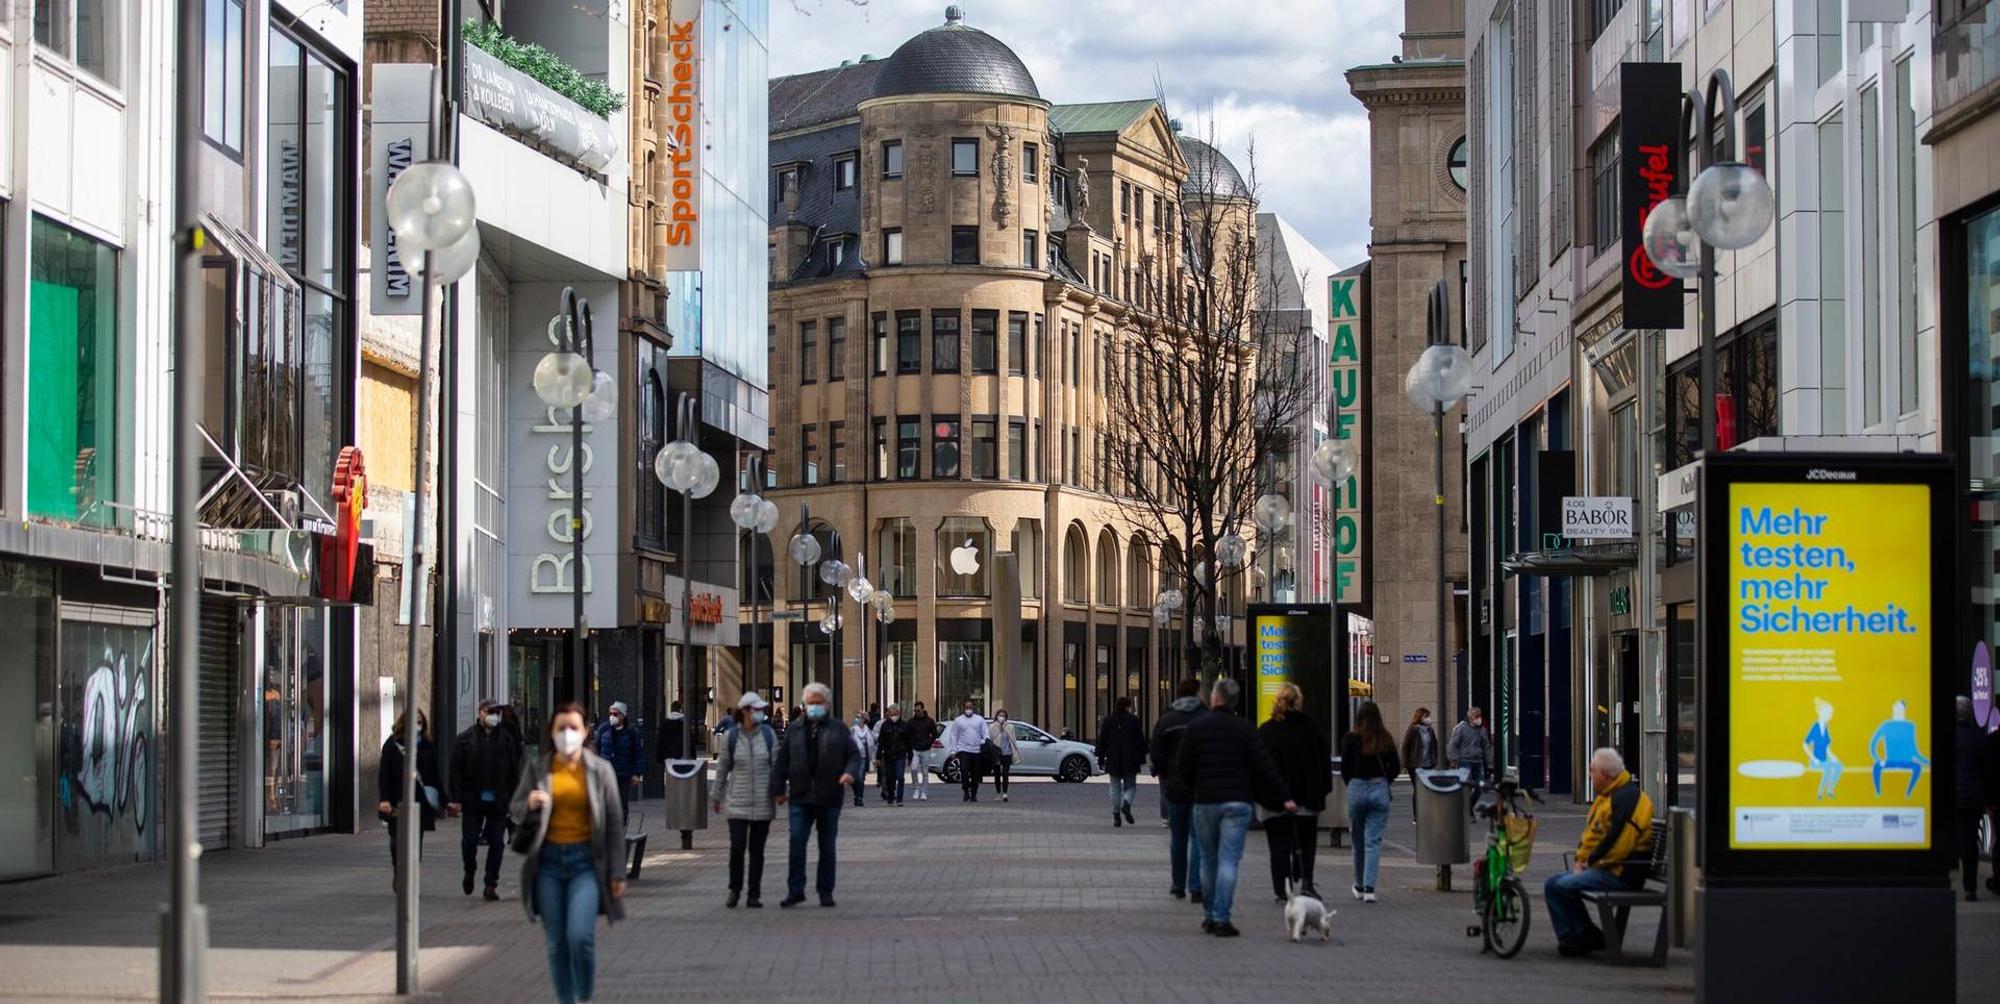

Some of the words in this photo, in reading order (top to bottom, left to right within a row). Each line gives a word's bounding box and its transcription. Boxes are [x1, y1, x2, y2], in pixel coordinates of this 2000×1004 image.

[531, 314, 593, 593] Bersha
[1806, 469, 1856, 480] JCDecaux
[1740, 506, 1828, 535] Mehr
[1740, 542, 1855, 573] testen,
[1740, 572, 1828, 600] mehr
[1740, 603, 1917, 633] Sicherheit.
